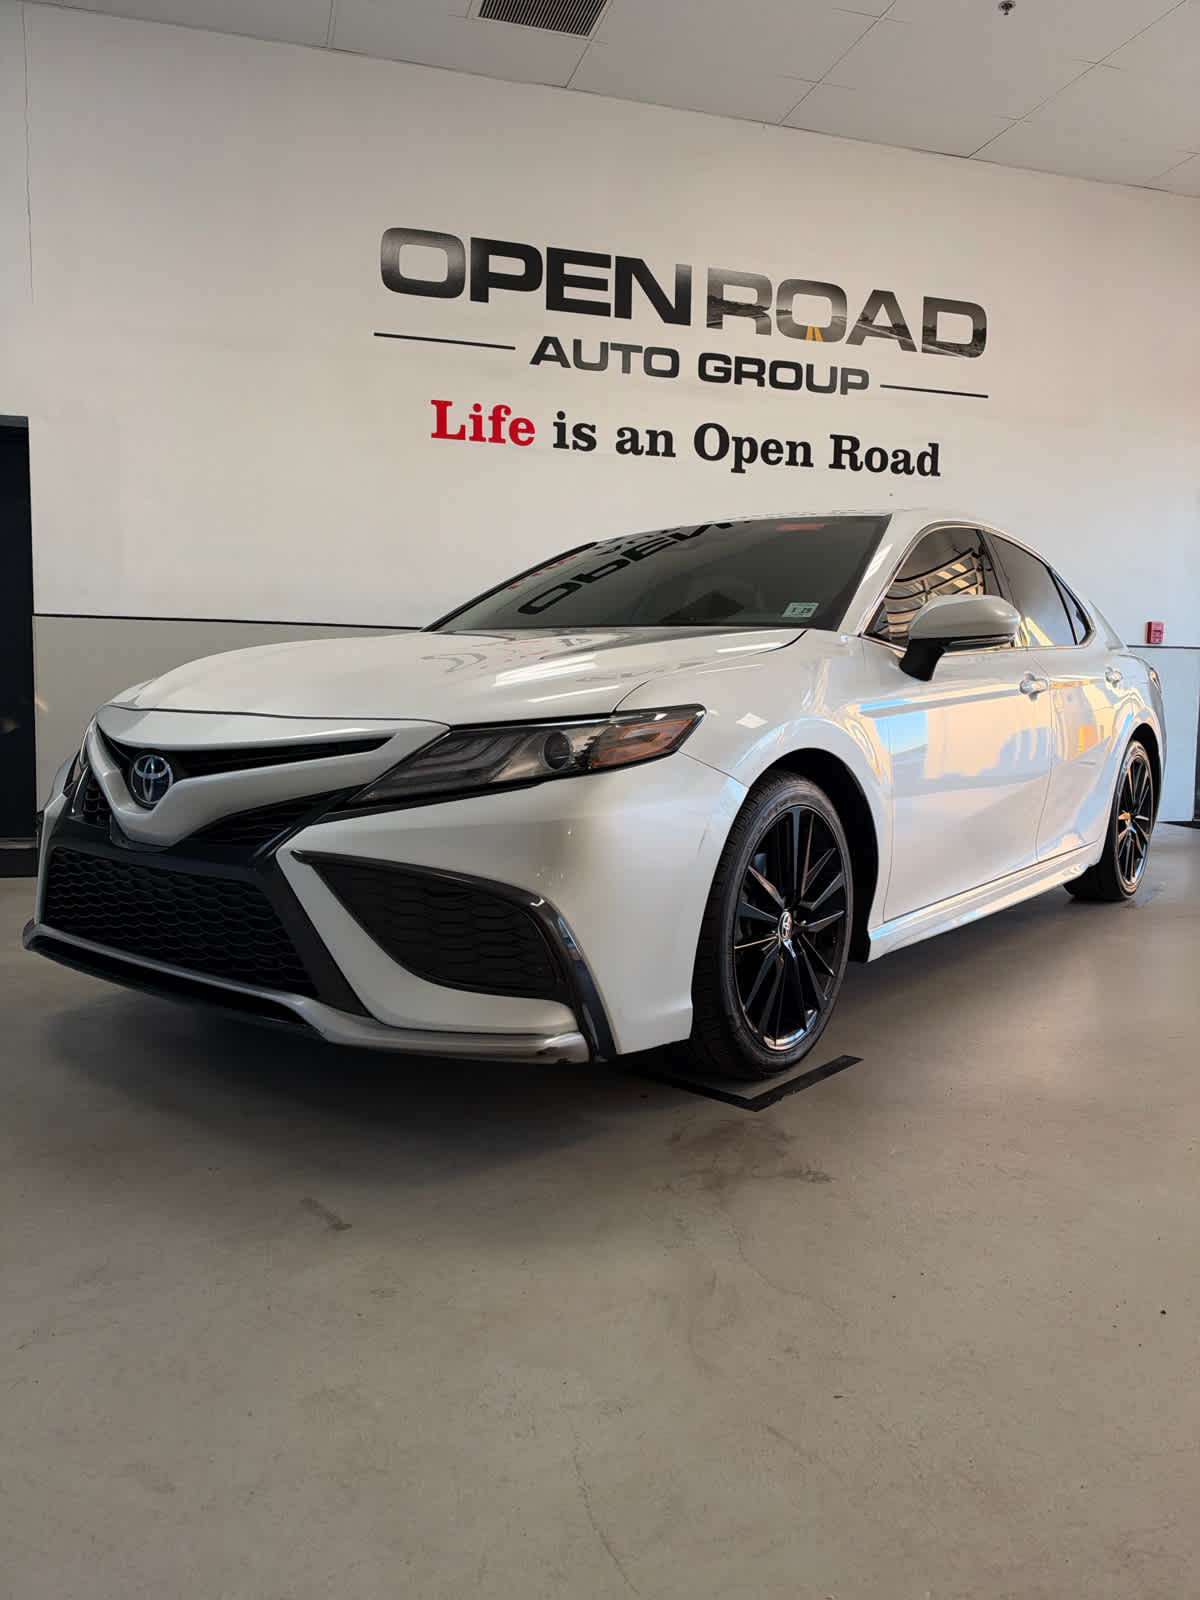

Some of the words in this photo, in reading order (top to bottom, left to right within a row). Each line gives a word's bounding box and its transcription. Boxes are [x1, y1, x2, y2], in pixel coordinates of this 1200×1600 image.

[379, 227, 693, 327] OPEN
[706, 267, 989, 359] ROAD
[529, 335, 681, 379] AUTO
[697, 352, 870, 396] GROUP
[430, 399, 537, 447] Life
[552, 410, 598, 453] is
[615, 426, 677, 459] an
[693, 422, 815, 475] Open
[827, 433, 942, 478] Road
